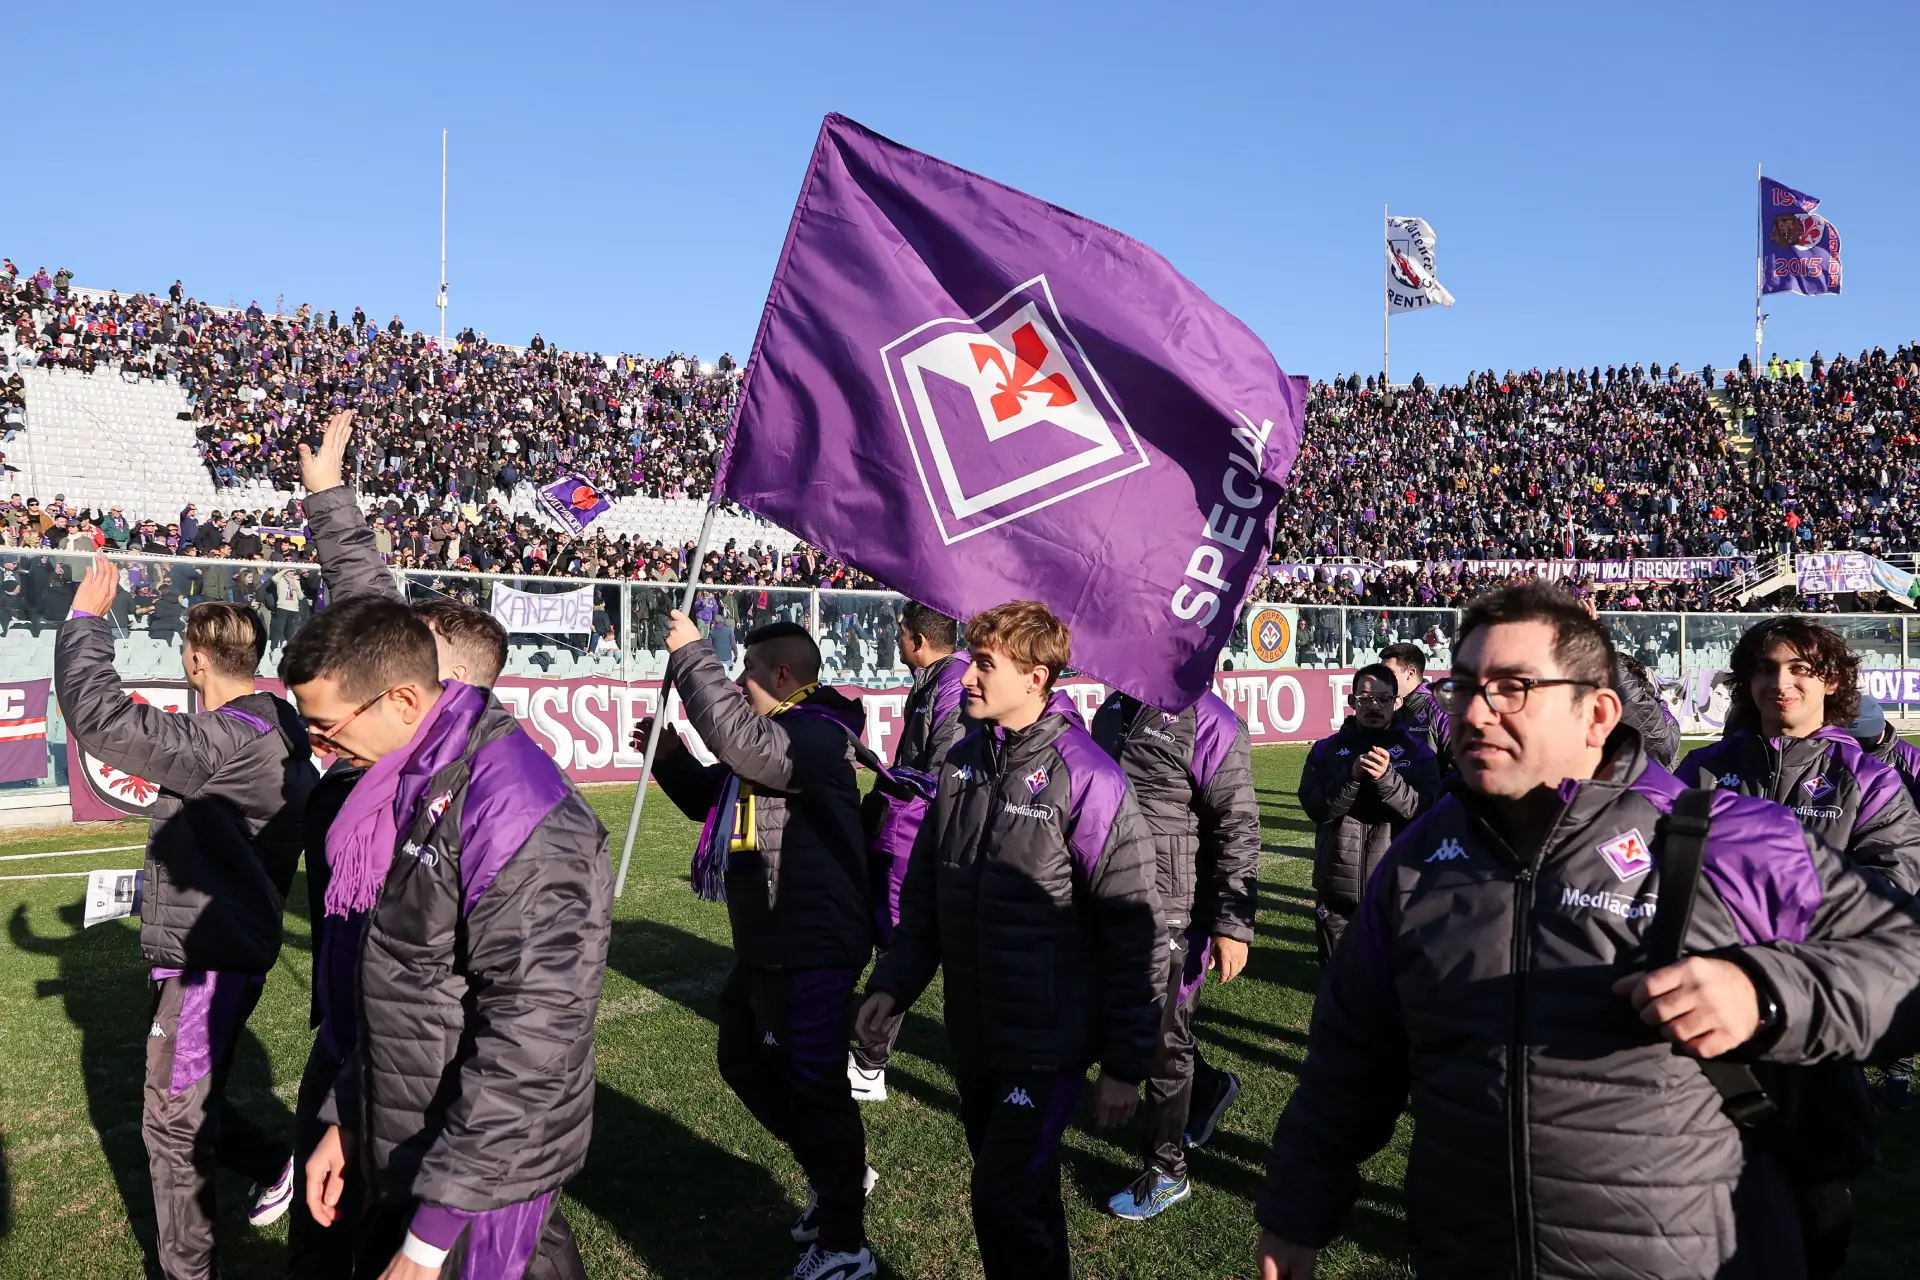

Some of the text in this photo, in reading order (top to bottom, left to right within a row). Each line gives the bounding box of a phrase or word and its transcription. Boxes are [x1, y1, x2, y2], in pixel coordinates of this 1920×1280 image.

[1773, 257, 1823, 277] 2015
[1171, 409, 1274, 628] SPECIAL
[1602, 561, 1630, 579] VIOLA
[1634, 560, 1688, 579] FIRENZE
[1258, 612, 1284, 625] GRUPPO
[1256, 646, 1285, 660] PIAGGE
[1003, 801, 1048, 820] Mediacom
[1788, 804, 1836, 819] ediacom
[1560, 887, 1657, 919] Mediacom
